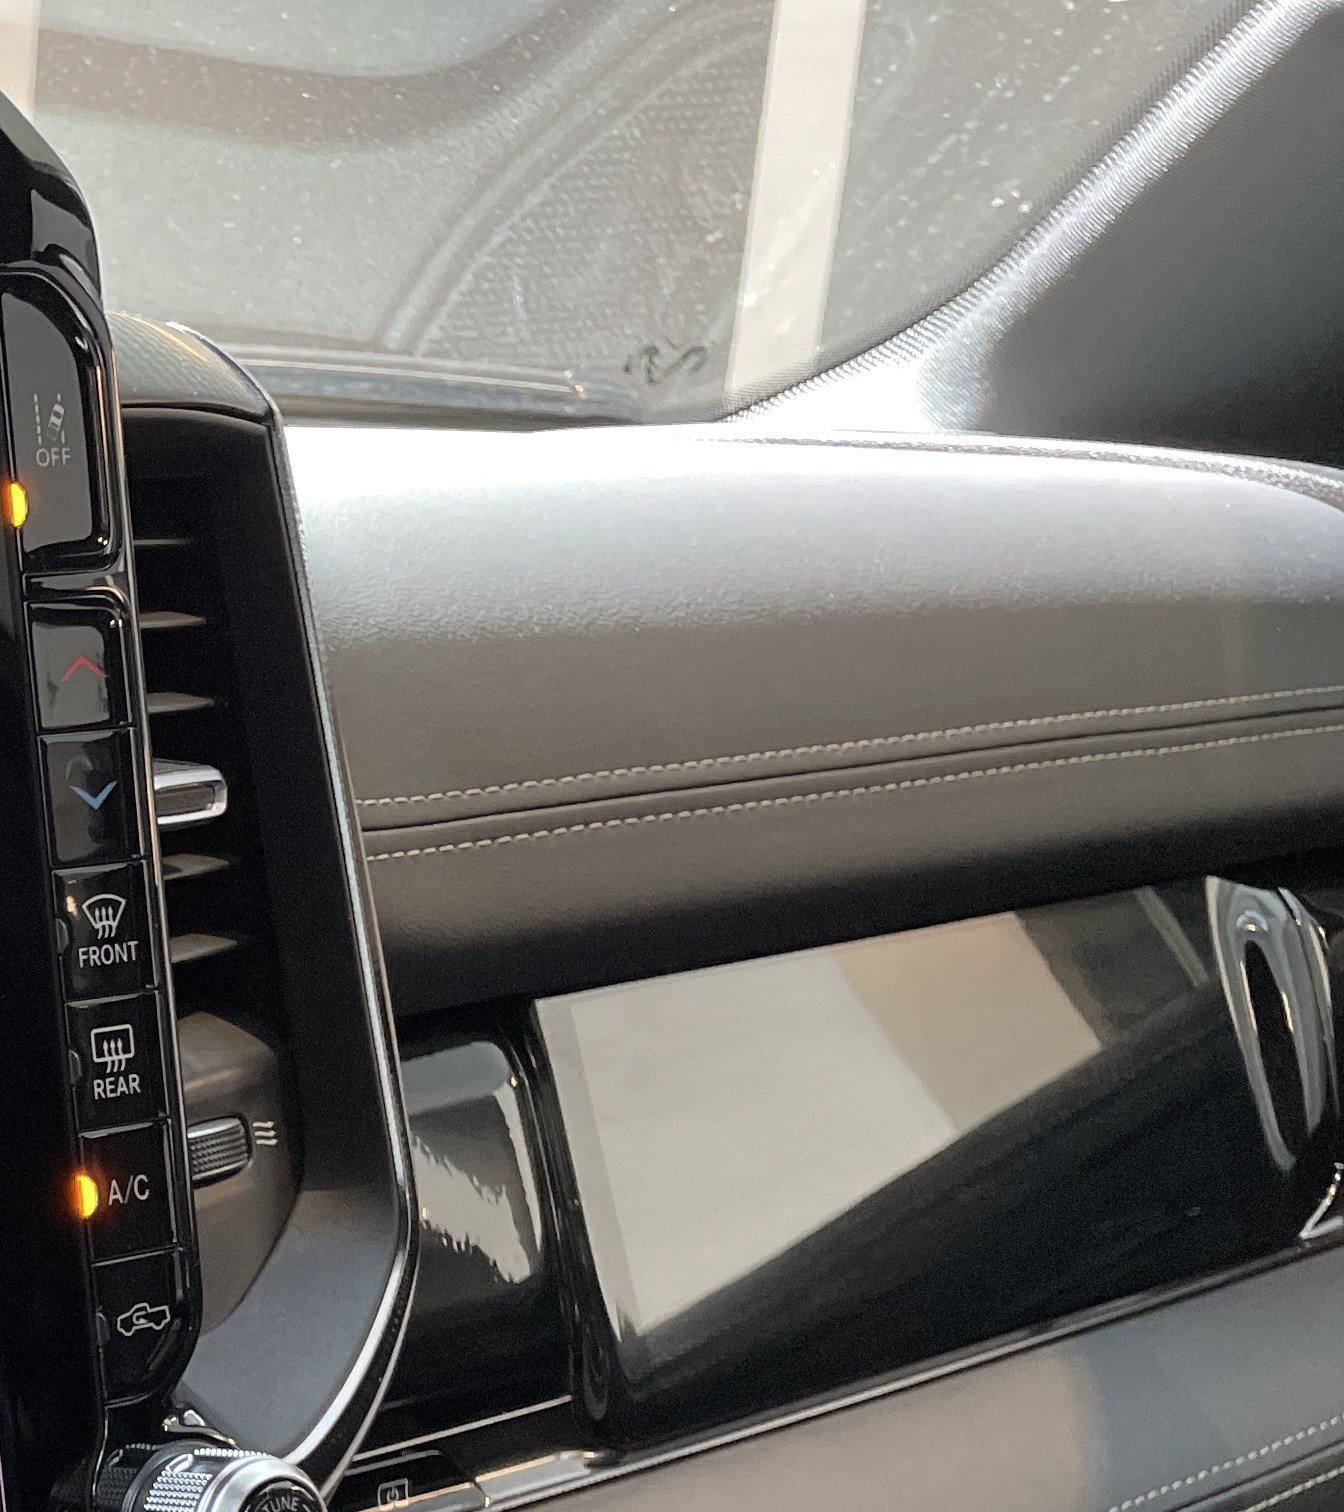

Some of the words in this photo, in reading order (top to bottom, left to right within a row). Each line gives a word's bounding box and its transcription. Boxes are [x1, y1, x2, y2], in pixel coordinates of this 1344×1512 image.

[35, 447, 72, 468] OFF
[78, 940, 139, 968] FRONT
[93, 1073, 141, 1100] REAR
[108, 1174, 150, 1206] A/C
